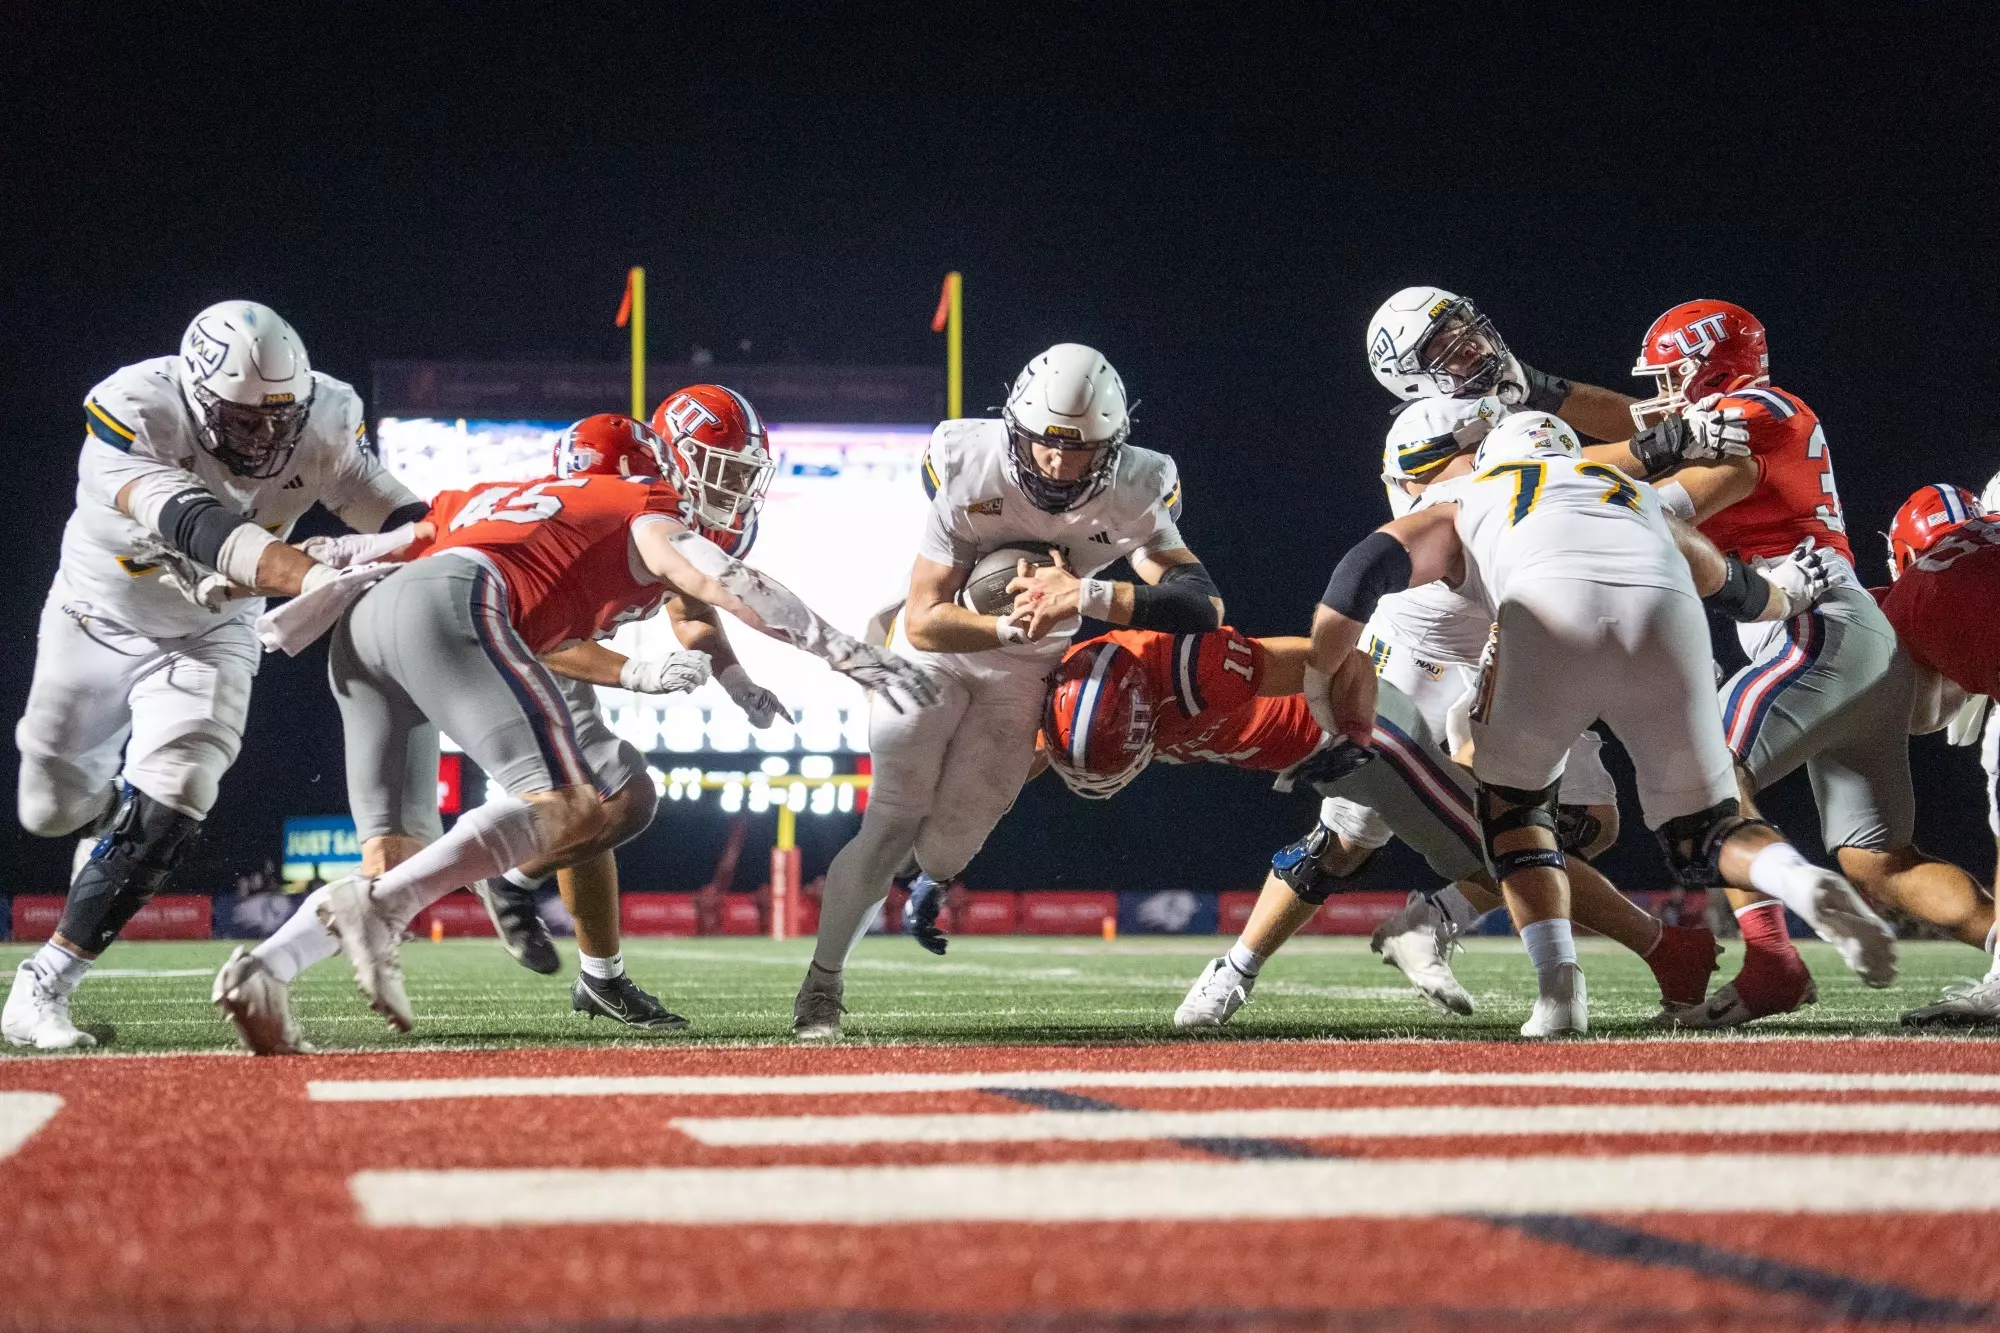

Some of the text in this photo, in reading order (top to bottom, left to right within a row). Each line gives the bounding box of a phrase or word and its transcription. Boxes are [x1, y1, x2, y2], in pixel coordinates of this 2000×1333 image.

[448, 477, 590, 533] 45
[1223, 639, 1255, 682] 11
[1415, 659, 1441, 675] NAU
